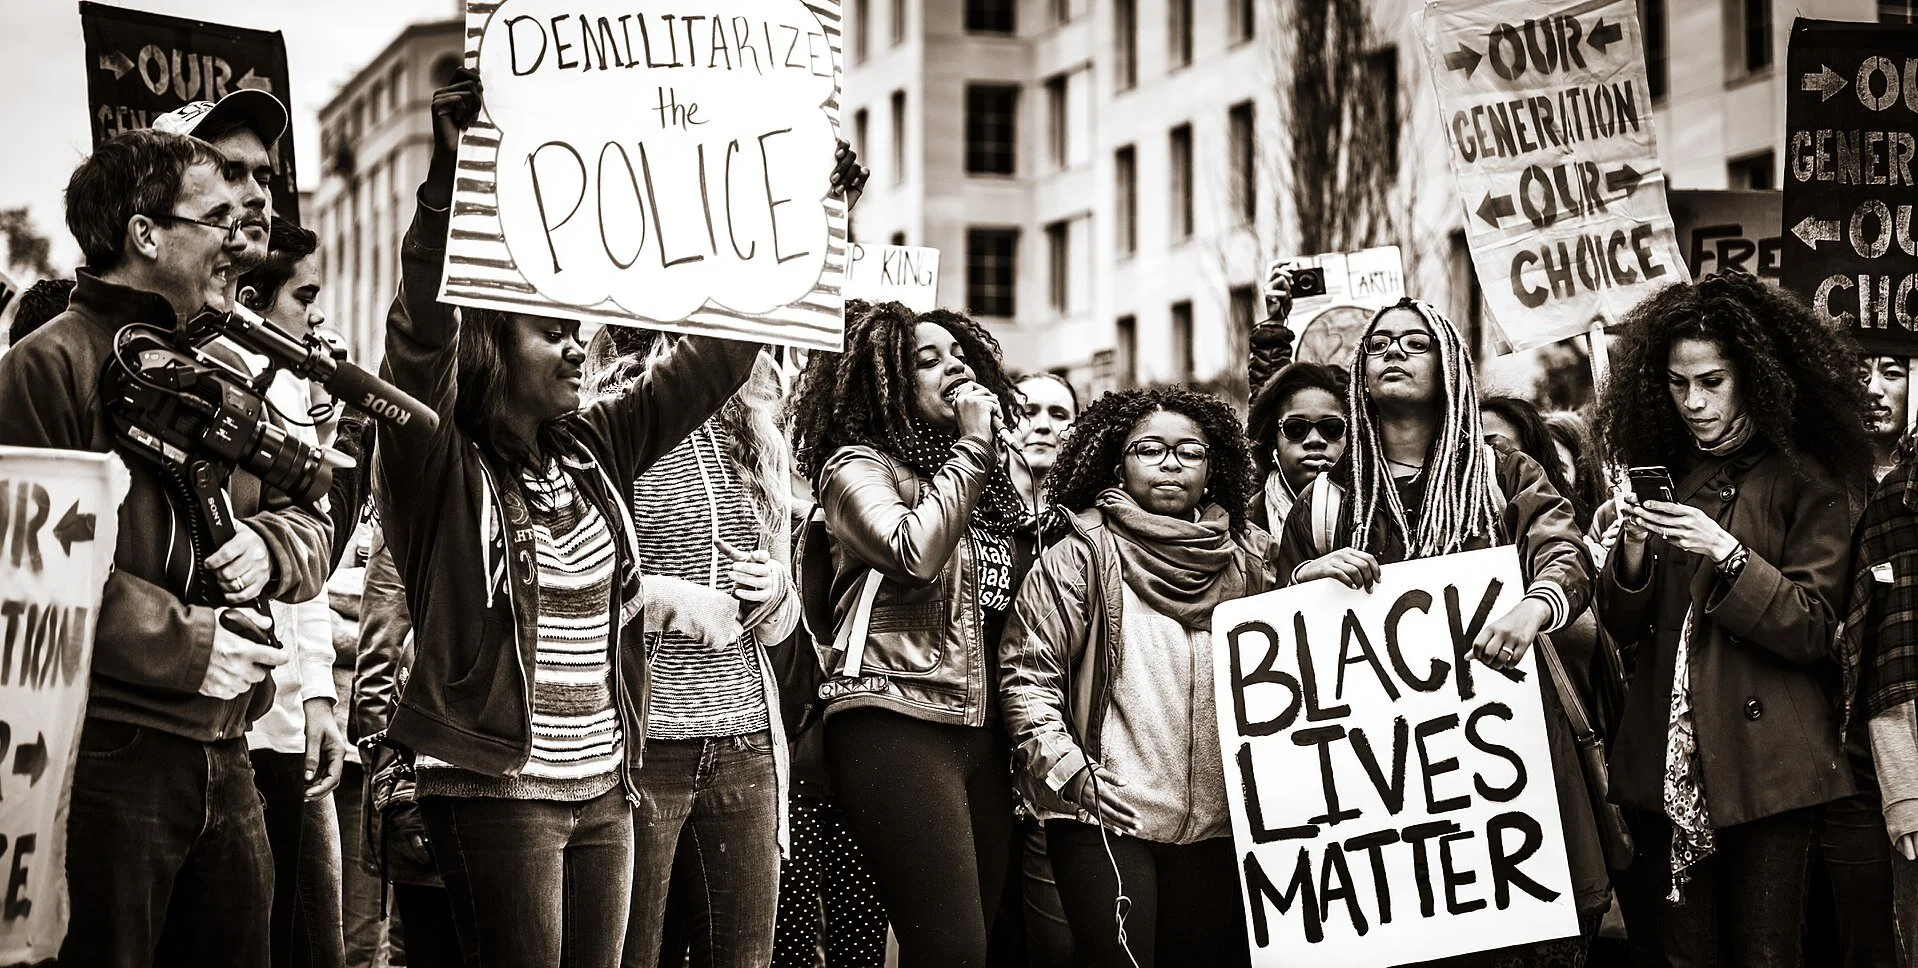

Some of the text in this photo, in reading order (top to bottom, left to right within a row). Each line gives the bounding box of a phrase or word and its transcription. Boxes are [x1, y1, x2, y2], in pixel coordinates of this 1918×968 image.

[138, 44, 232, 102] OUR
[503, 13, 835, 77] DEMILITARIZE
[1488, 15, 1589, 81] OUR
[652, 86, 709, 132] the
[1452, 79, 1640, 163] GENERATION
[524, 128, 809, 274] POLICE
[1519, 161, 1609, 227] OUR
[881, 249, 932, 287] KING
[1509, 223, 1667, 308] CHOICE
[207, 497, 223, 527] SONY
[1227, 577, 1526, 736] BLACK
[1235, 702, 1528, 843] LIVES
[1243, 811, 1561, 948] MATTER
